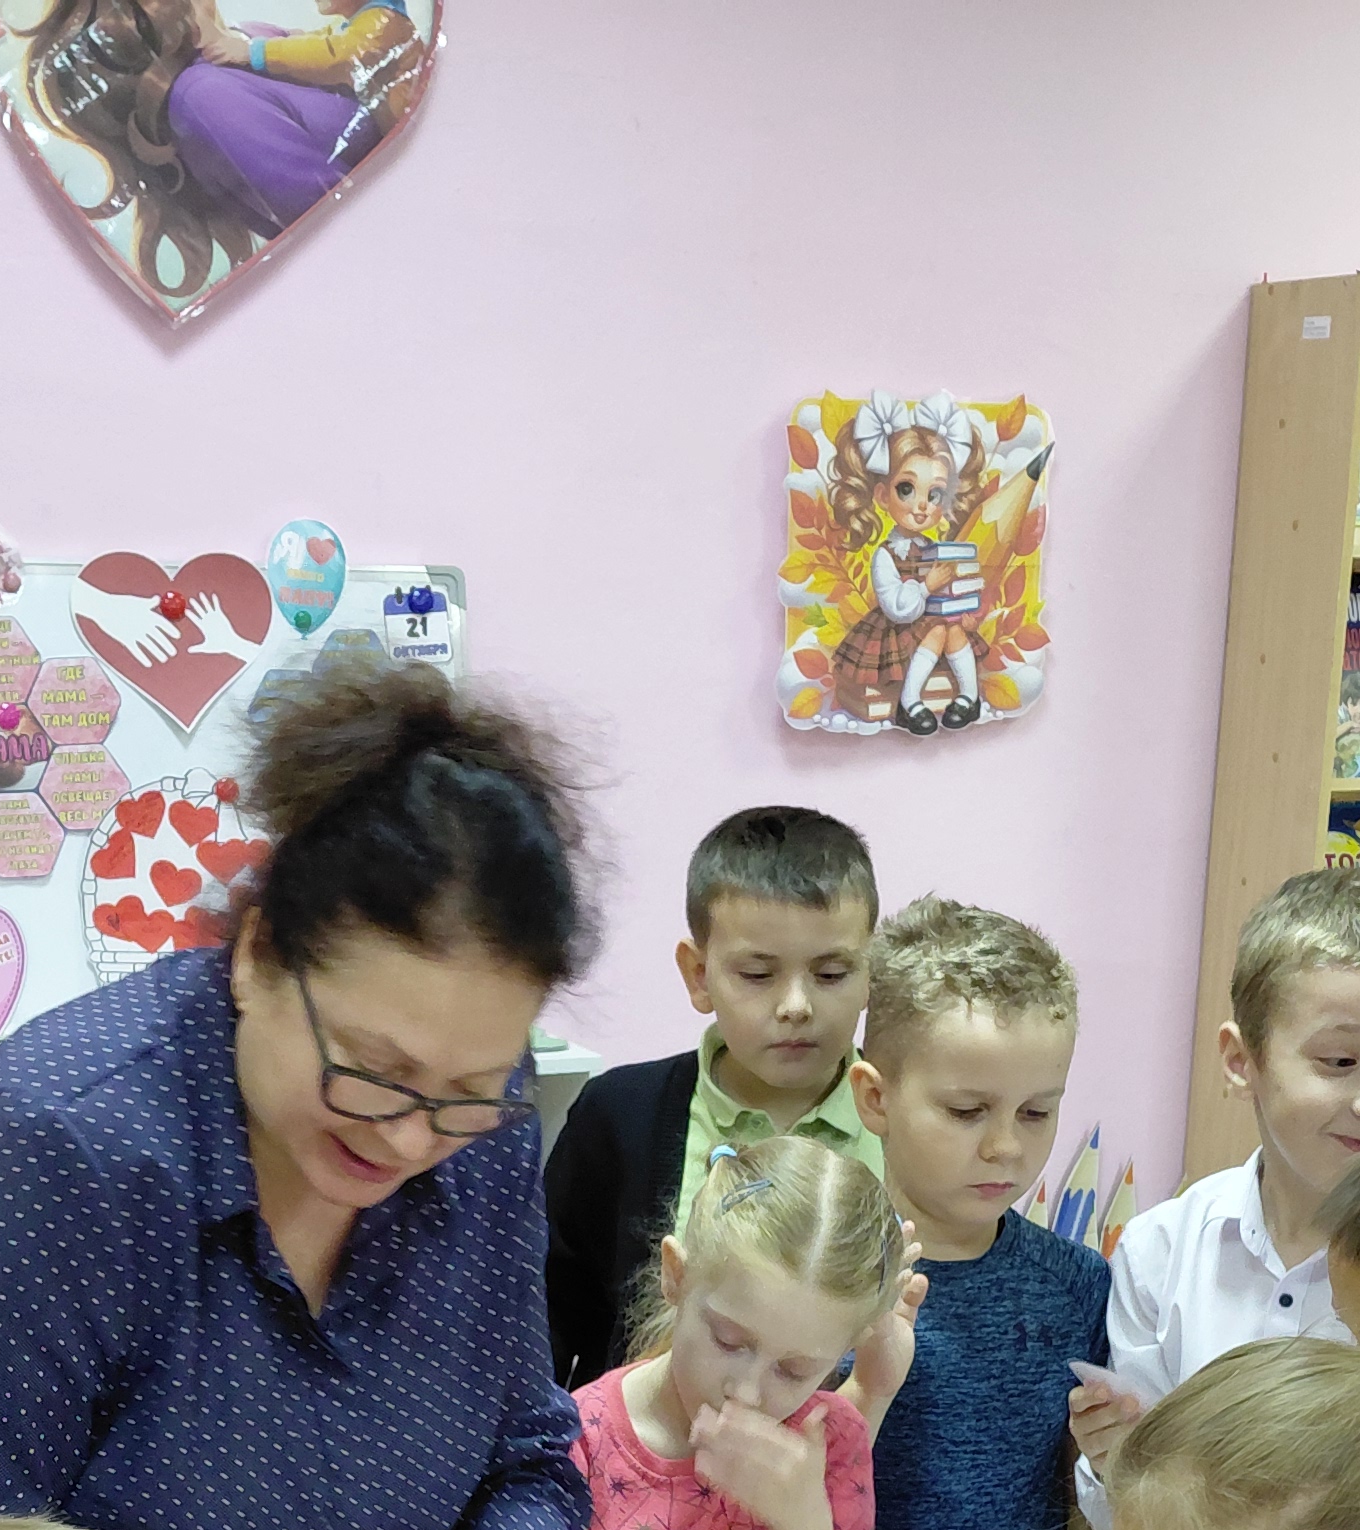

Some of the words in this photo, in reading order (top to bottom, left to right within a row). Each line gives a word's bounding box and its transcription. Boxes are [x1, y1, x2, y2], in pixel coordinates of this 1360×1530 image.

[405, 617, 427, 637] 21
[56, 664, 85, 680] ГДЕ
[42, 690, 87, 703] МАМА
[42, 714, 74, 727] ТАМ
[77, 712, 110, 728] ДОМ
[63, 771, 104, 783] МАМЫ
[52, 789, 116, 804] ОСВЕЩАЕТ
[59, 808, 88, 822] ВЕСЬ
